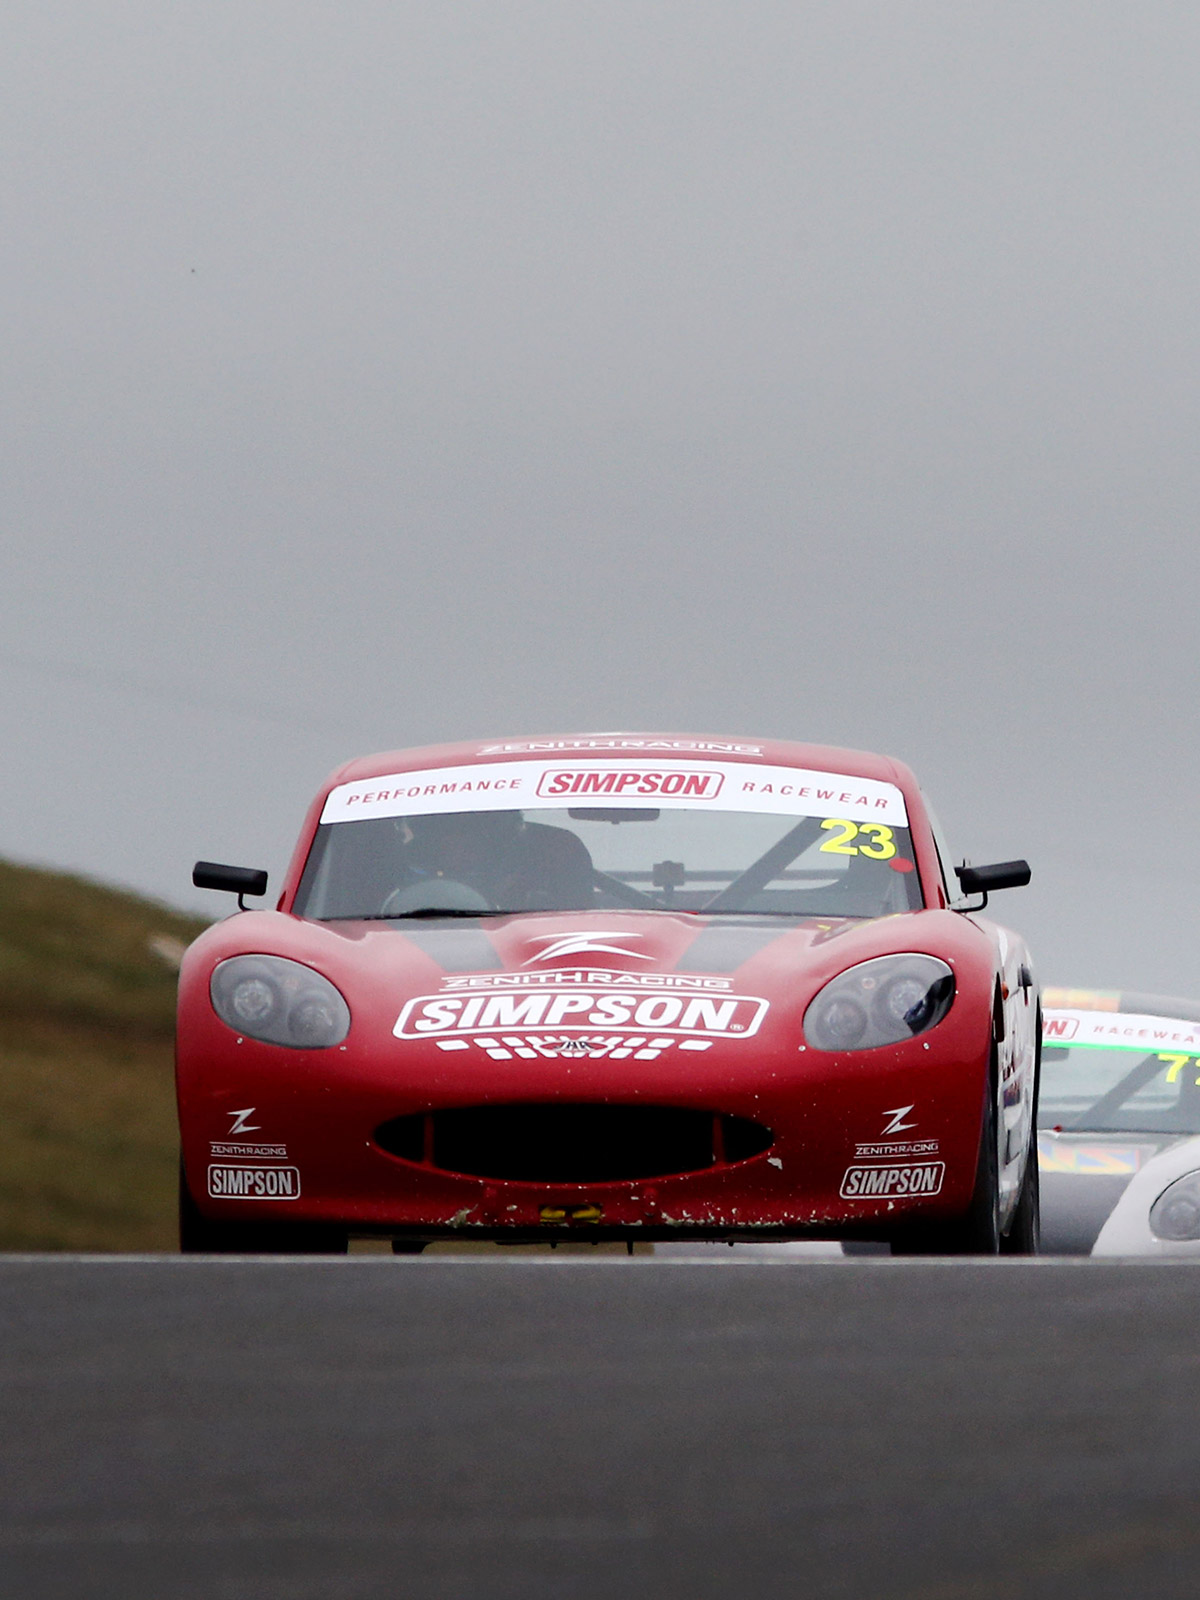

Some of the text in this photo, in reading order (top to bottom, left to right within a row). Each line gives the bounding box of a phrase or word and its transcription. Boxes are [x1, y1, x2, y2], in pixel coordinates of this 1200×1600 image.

[346, 773, 889, 809] PERFORMANCE SIMPSON RACEWEAR
[818, 817, 897, 860] 23
[414, 994, 739, 1032] SIMPSON
[212, 1169, 293, 1195] SIMPSON
[845, 1167, 938, 1195] SIMPSON
